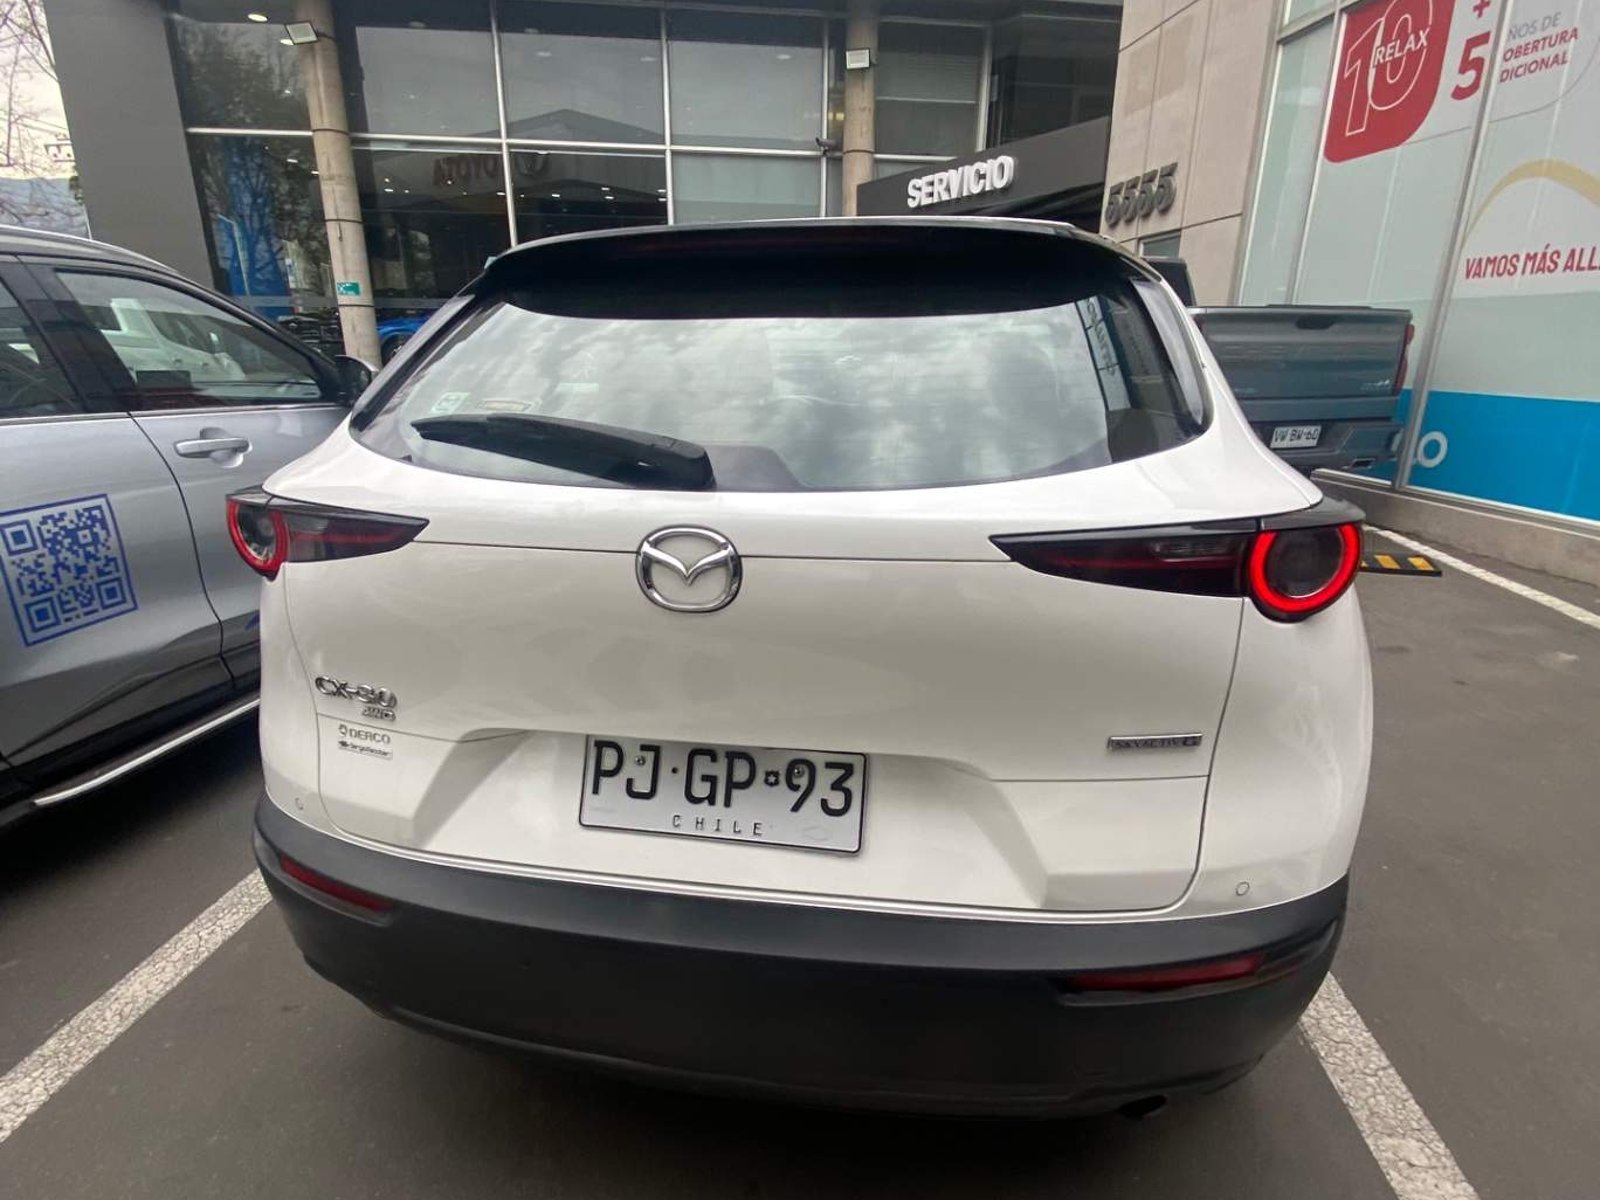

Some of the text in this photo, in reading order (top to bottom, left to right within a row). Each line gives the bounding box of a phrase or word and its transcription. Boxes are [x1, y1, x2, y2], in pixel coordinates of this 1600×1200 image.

[1541, 11, 1562, 32] DE
[1372, 28, 1430, 67] RELAX
[1503, 27, 1579, 63] OBERTURA
[1451, 31, 1491, 101] 5
[1500, 51, 1570, 84] DICIONAL
[907, 155, 1015, 208] SERVICIO
[1104, 163, 1178, 228] 5555
[1465, 243, 1600, 280] VAMOS MÁS ALL
[348, 728, 391, 744] DERCO
[672, 814, 764, 837] CHILE
